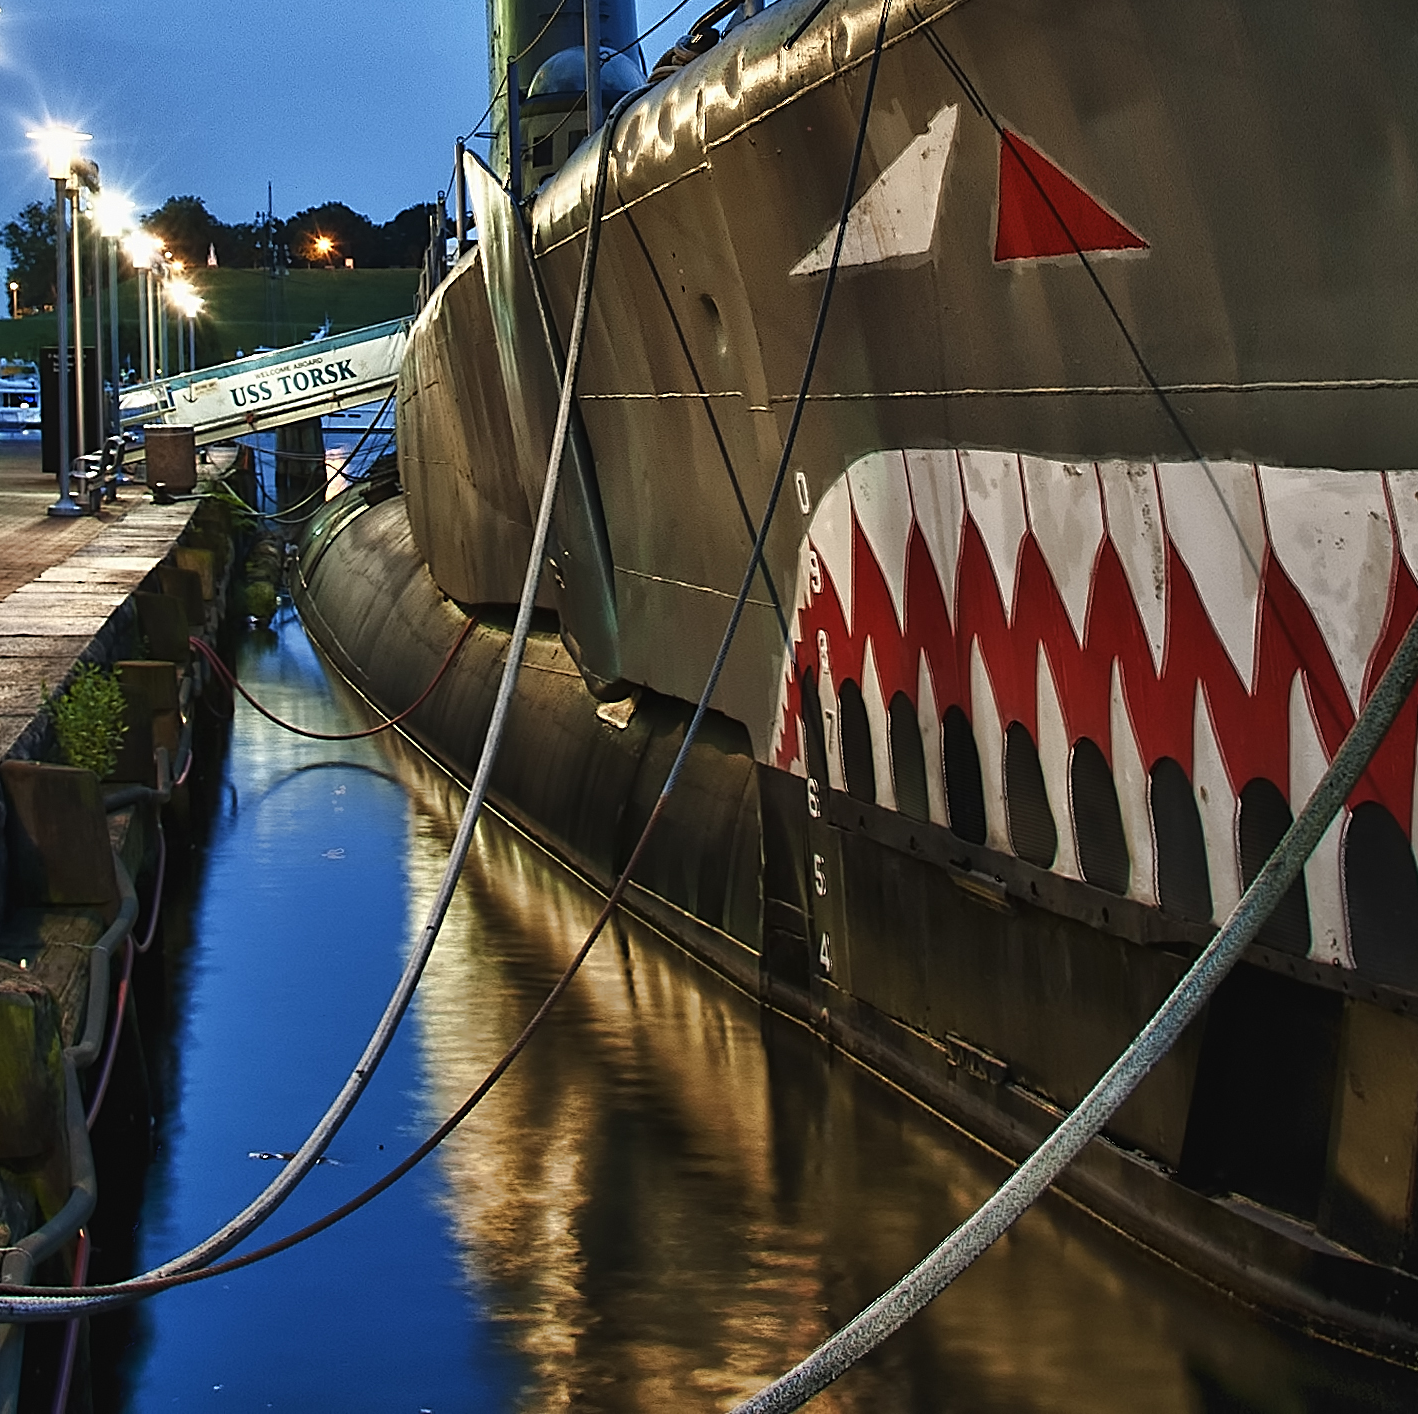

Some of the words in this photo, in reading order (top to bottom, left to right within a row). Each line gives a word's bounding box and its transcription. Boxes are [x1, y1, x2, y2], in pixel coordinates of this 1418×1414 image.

[230, 381, 273, 407] USS
[278, 359, 358, 395] TORSK
[255, 365, 292, 380] WELCOME
[293, 357, 323, 369] ABOARD
[809, 550, 824, 594] 9
[824, 708, 835, 753] 7
[807, 777, 822, 818] 6
[814, 853, 828, 897] 5
[819, 933, 832, 974] 4
